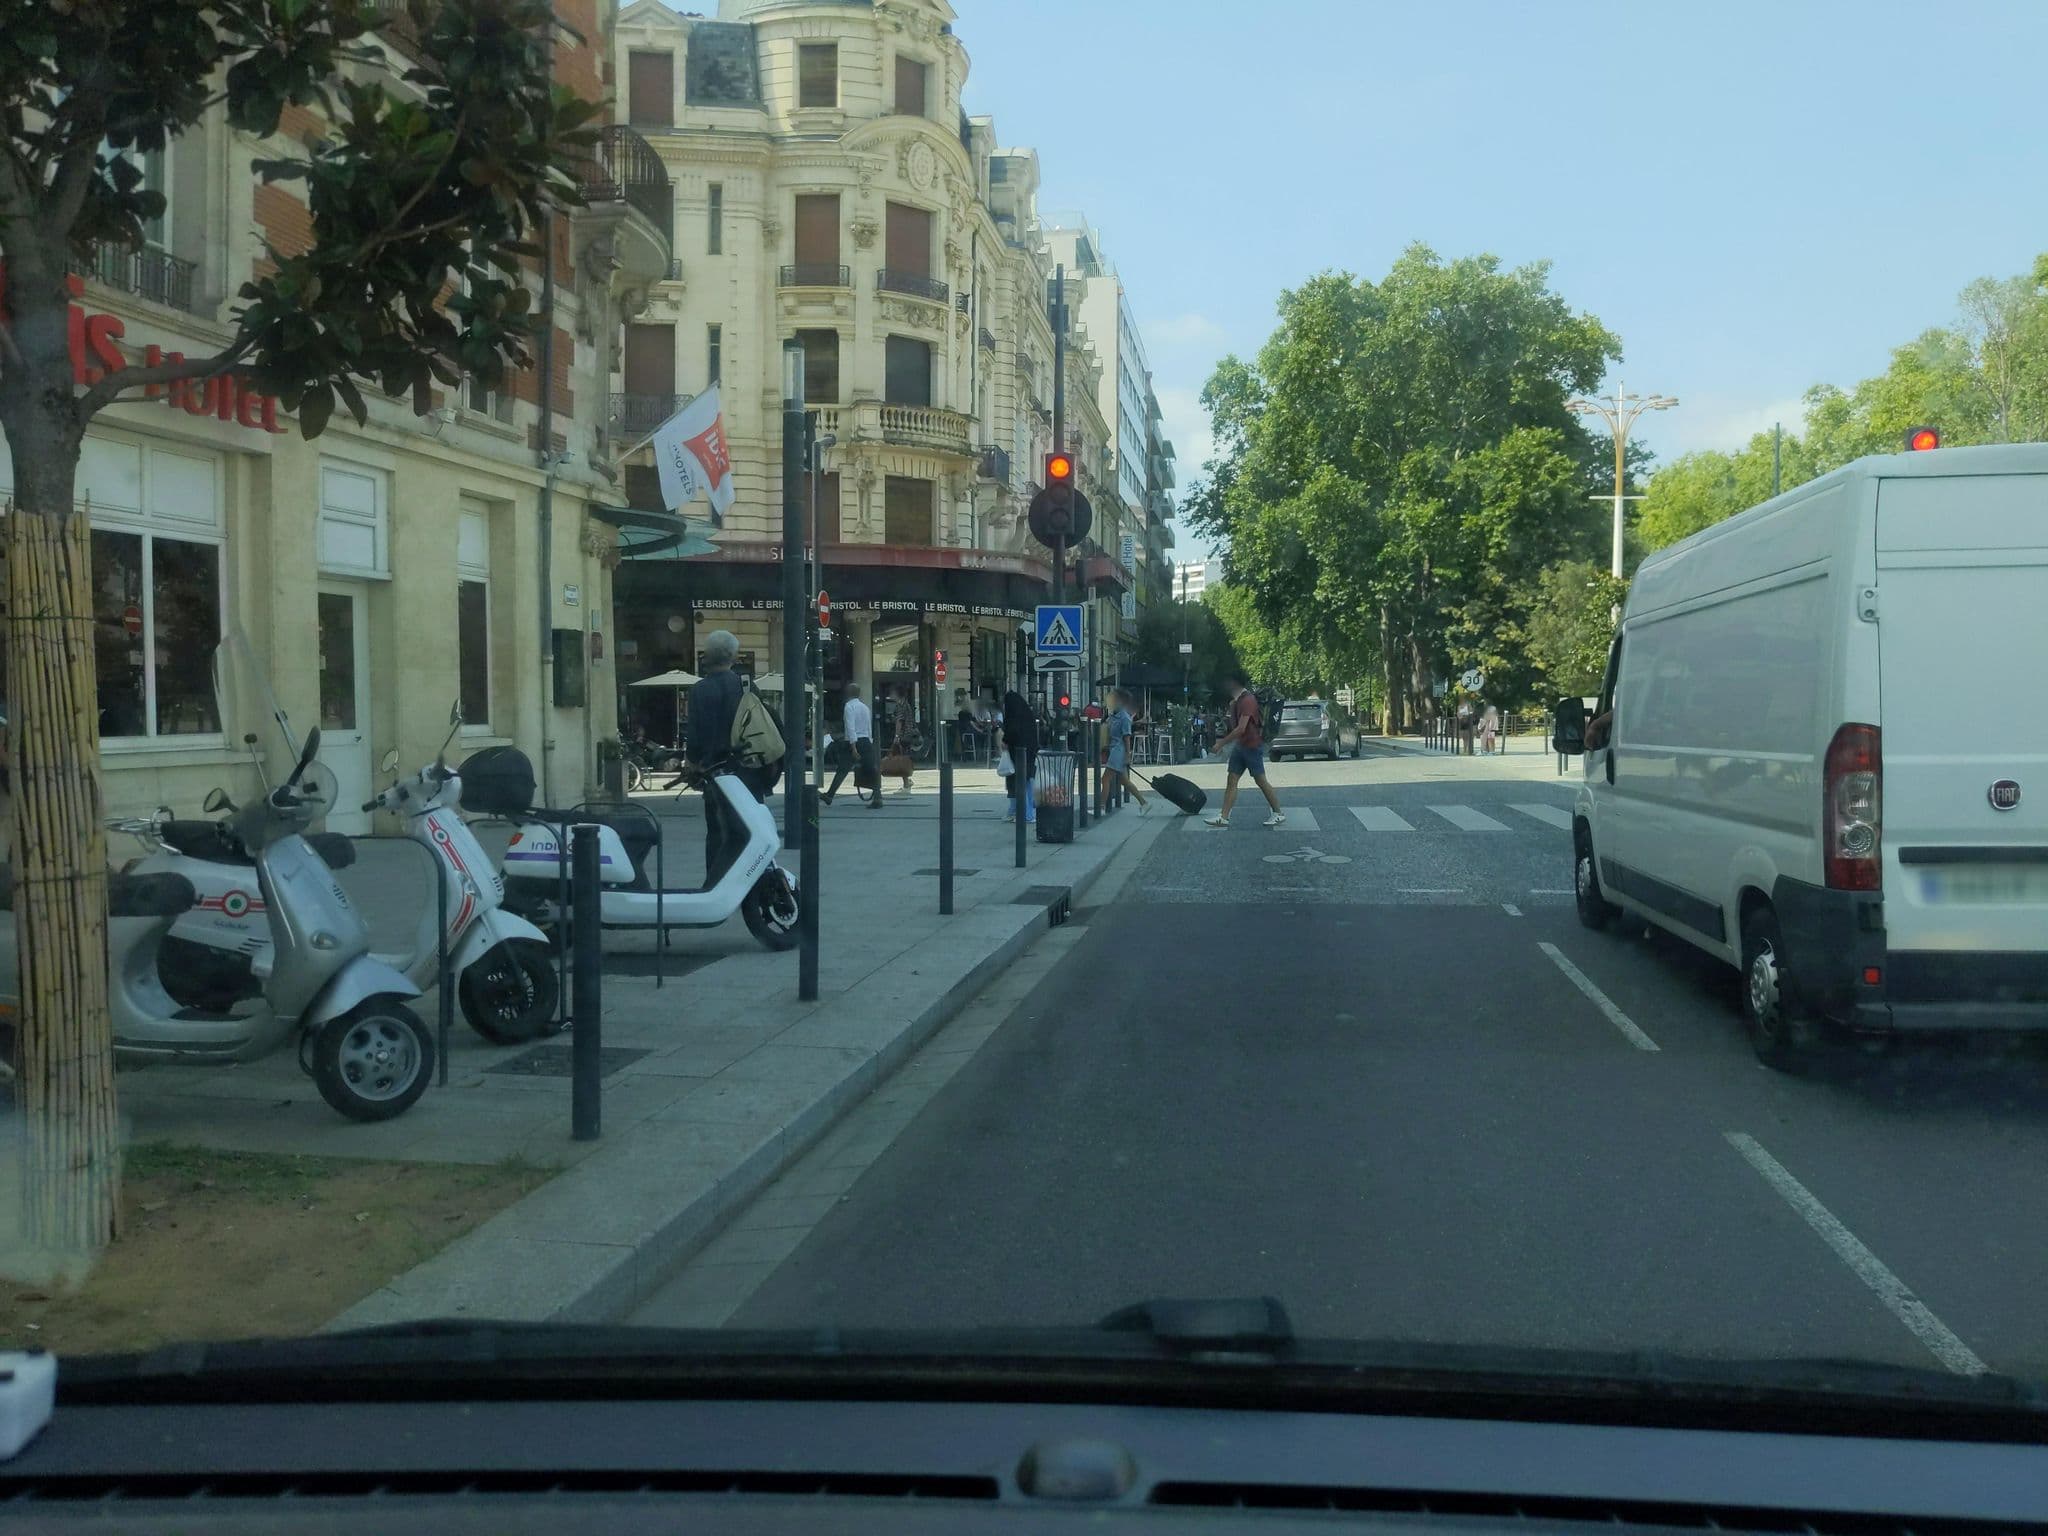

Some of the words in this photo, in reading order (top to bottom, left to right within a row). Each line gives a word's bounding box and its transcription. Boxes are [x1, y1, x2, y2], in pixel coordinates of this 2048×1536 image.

[1122, 535, 1133, 558] Hotel
[692, 600, 703, 608] LE
[706, 600, 744, 608] BRISTOL
[752, 601, 764, 609] LE
[829, 601, 862, 610] RISTOL
[869, 601, 880, 609] LE
[882, 601, 918, 610] BRISTOL
[925, 603, 934, 611] LE
[937, 603, 967, 613] BRISTOL
[972, 605, 980, 613] LE
[980, 606, 1004, 615] BRISTOL
[1466, 676, 1479, 685] 30
[1996, 787, 2016, 802] FIAT
